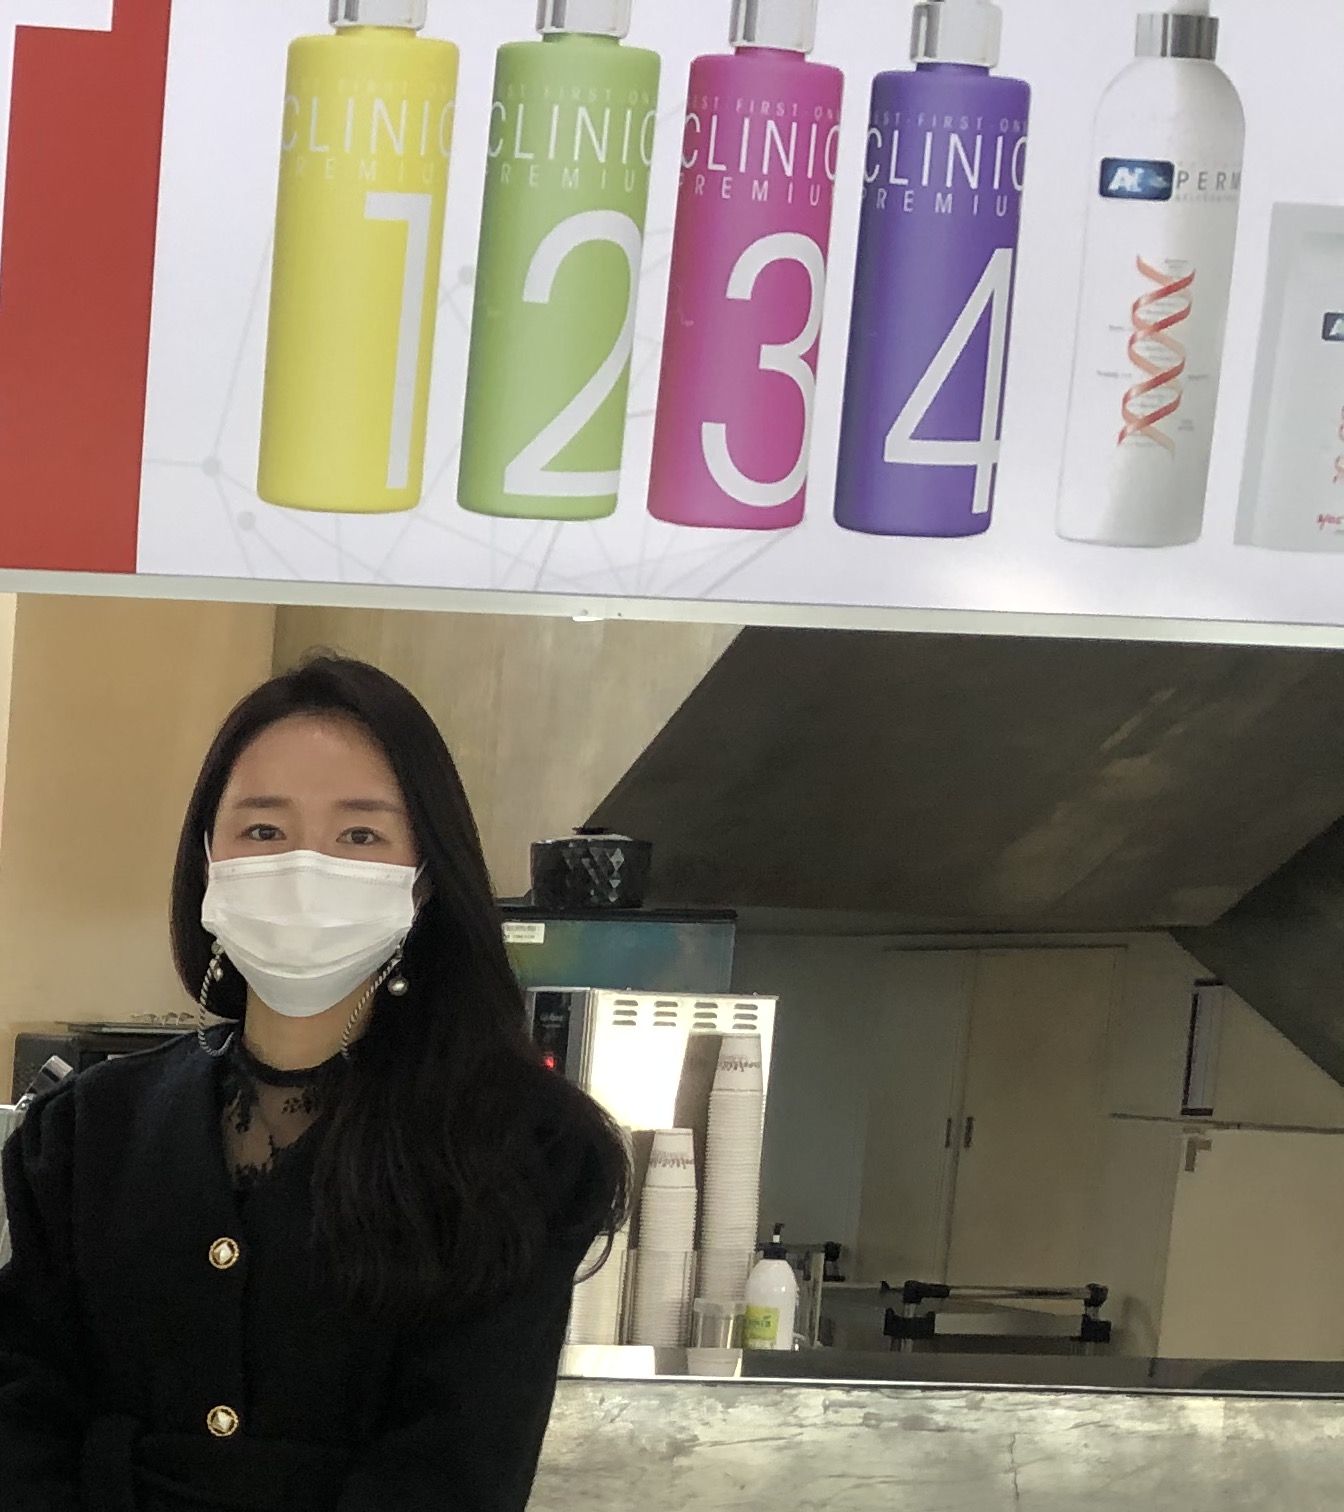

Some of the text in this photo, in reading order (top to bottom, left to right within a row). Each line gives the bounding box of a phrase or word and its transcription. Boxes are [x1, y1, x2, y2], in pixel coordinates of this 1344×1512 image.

[488, 101, 657, 167] CLINIC
[681, 112, 842, 182] CLINIC
[863, 127, 1028, 191] CLINIC
[365, 191, 433, 491] 1
[503, 210, 643, 498] 2
[700, 231, 826, 508] 3
[884, 247, 1013, 514] 4
